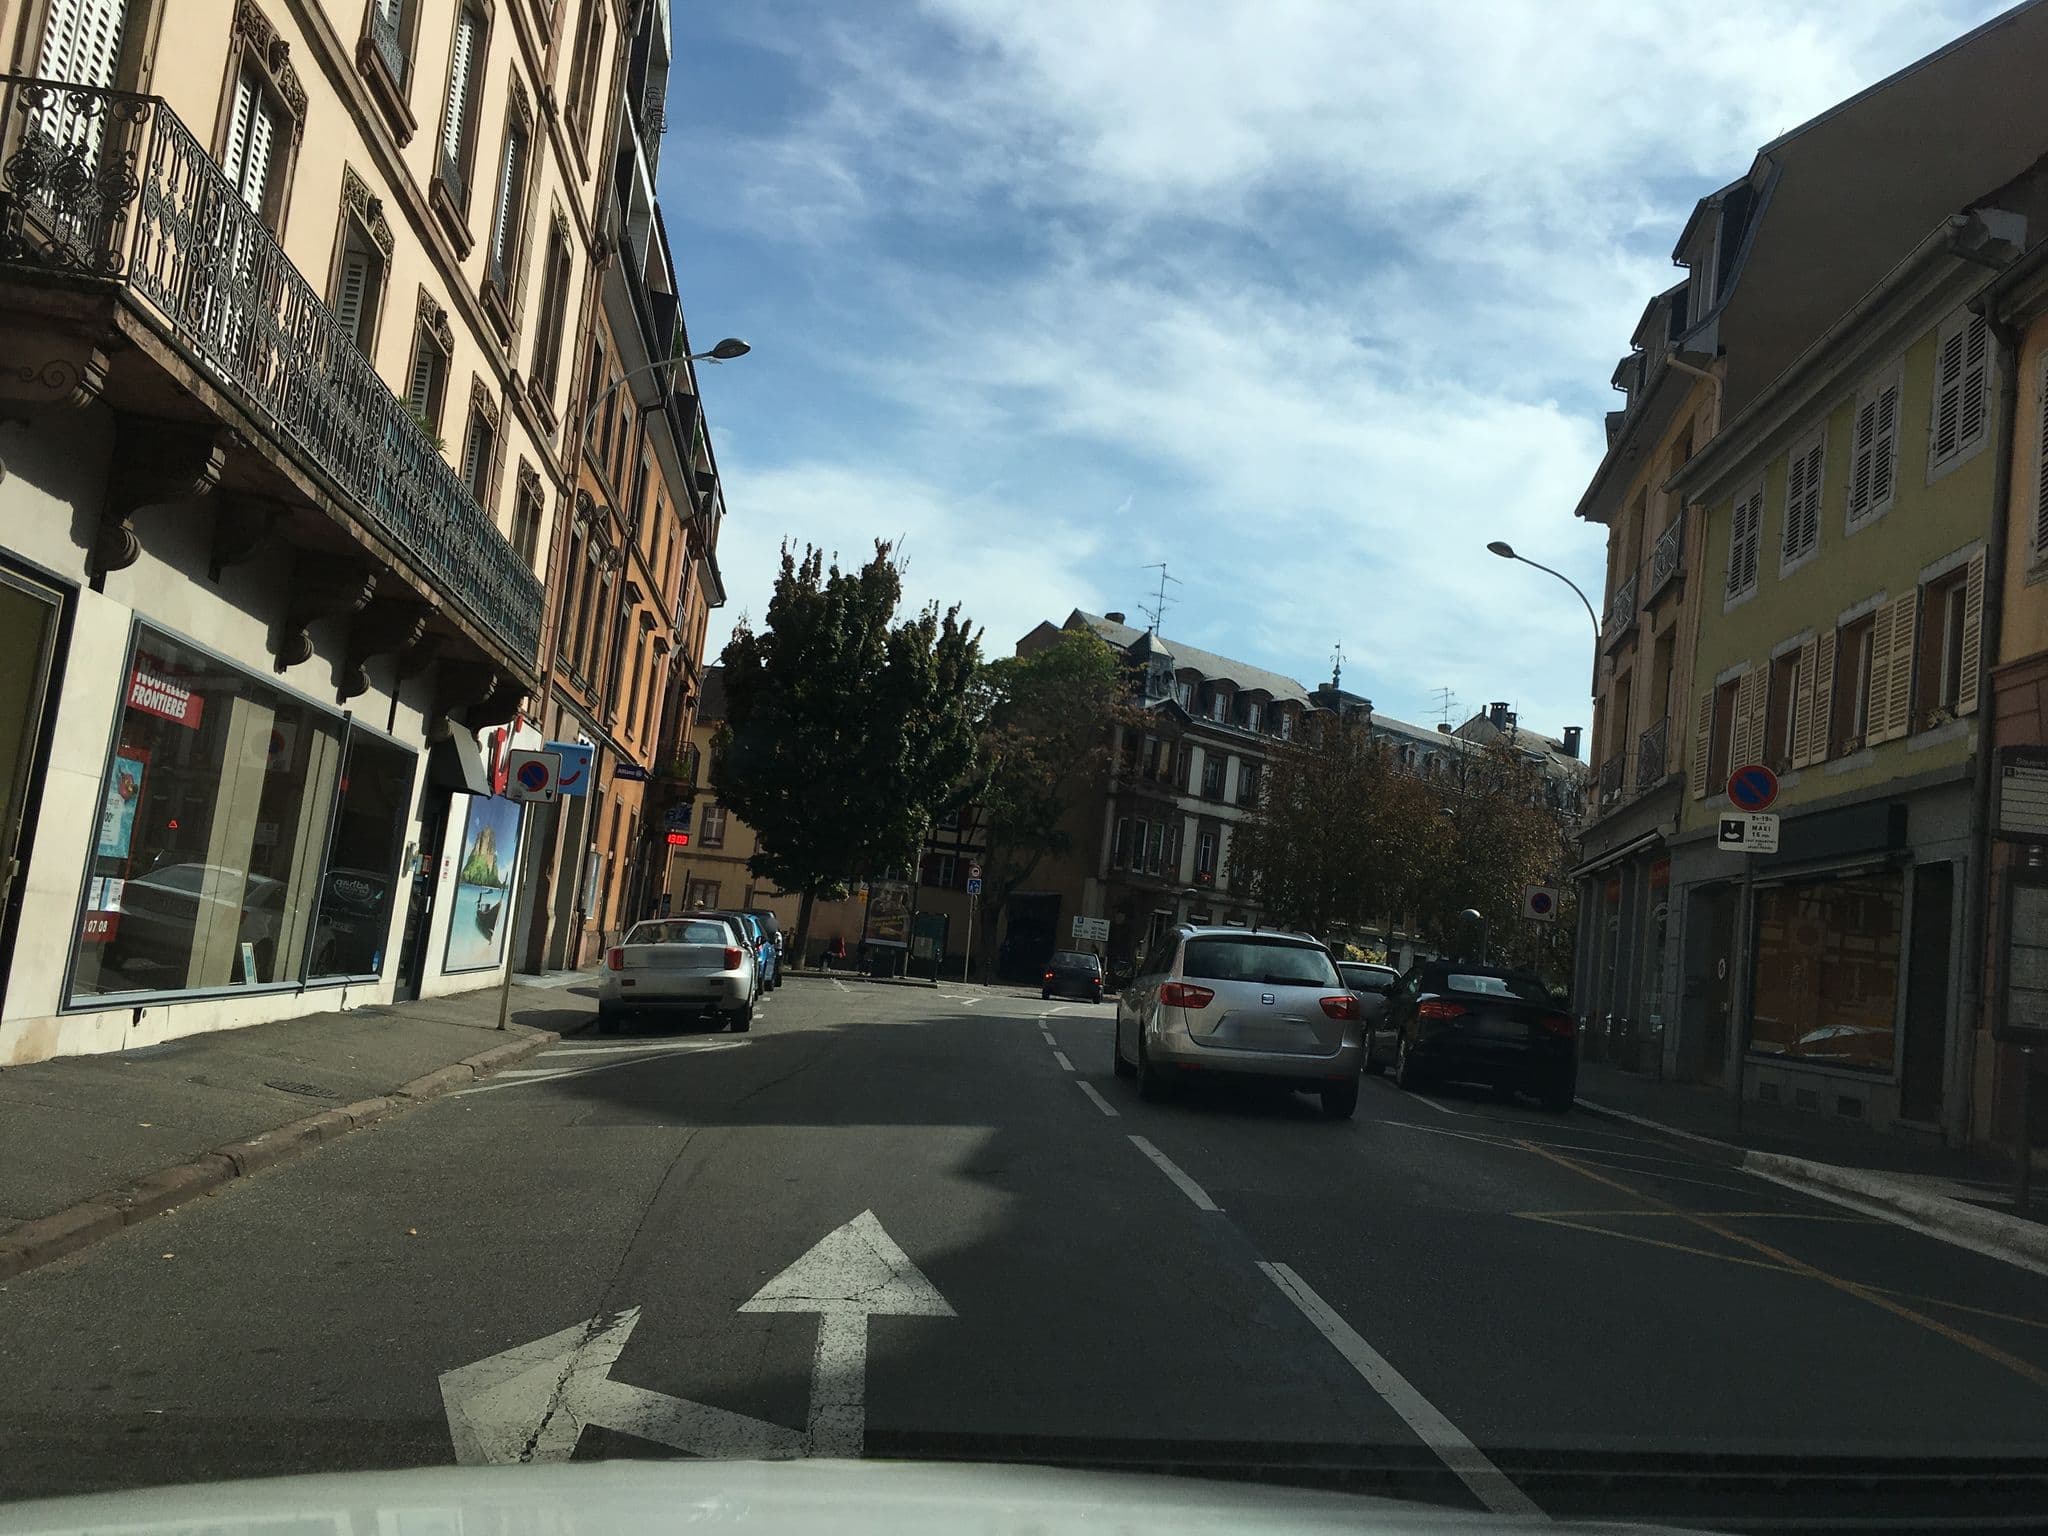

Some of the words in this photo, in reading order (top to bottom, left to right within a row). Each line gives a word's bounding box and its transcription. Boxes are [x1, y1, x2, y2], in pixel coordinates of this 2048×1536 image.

[130, 683, 188, 719] FRONTIERES
[136, 666, 191, 701] NOUVELLES
[87, 919, 98, 933] 07
